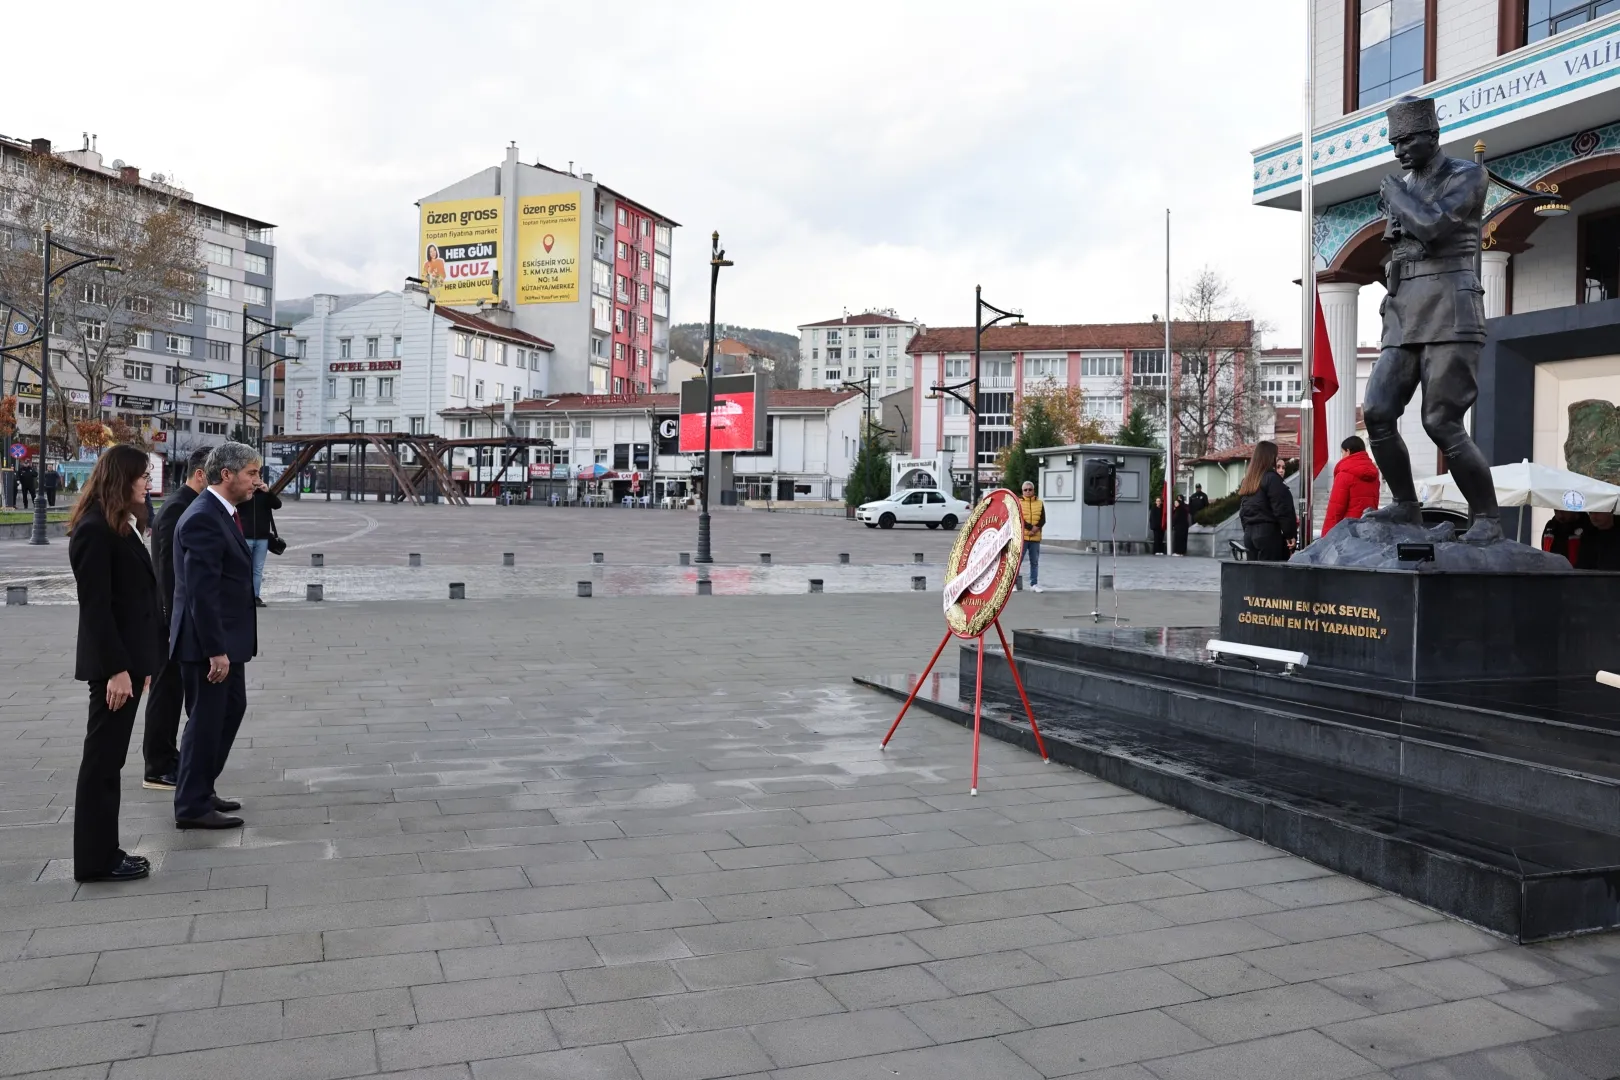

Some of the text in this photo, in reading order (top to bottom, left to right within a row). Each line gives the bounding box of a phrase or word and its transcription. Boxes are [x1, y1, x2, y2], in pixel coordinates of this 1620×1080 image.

[1458, 69, 1548, 114] KÜTAHYA
[523, 202, 577, 216] özen gross
[426, 208, 498, 226] özen gross
[522, 218, 539, 226] toptan
[540, 217, 558, 226] fiyatına
[426, 228, 498, 240] toptan fiyatına market
[445, 243, 493, 260] HER GÜN
[449, 261, 490, 278] UCUZ
[522, 258, 575, 268] ESKİŞEHİR YOLU
[530, 267, 542, 276] KM
[542, 267, 558, 275] VEFA
[559, 266, 573, 274] MH.
[444, 283, 457, 291] HER
[457, 280, 476, 289] ÜRÜN
[521, 283, 575, 291] KÜTAHYA/MERKEZ
[329, 362, 365, 373] OTEL
[296, 388, 304, 431] OTEL
[1243, 595, 1381, 623] “VATANINI EN ÇOK SEVEN,
[1238, 612, 1387, 640] GÖREVİNİ EN İYİ YAPANDIR.”
